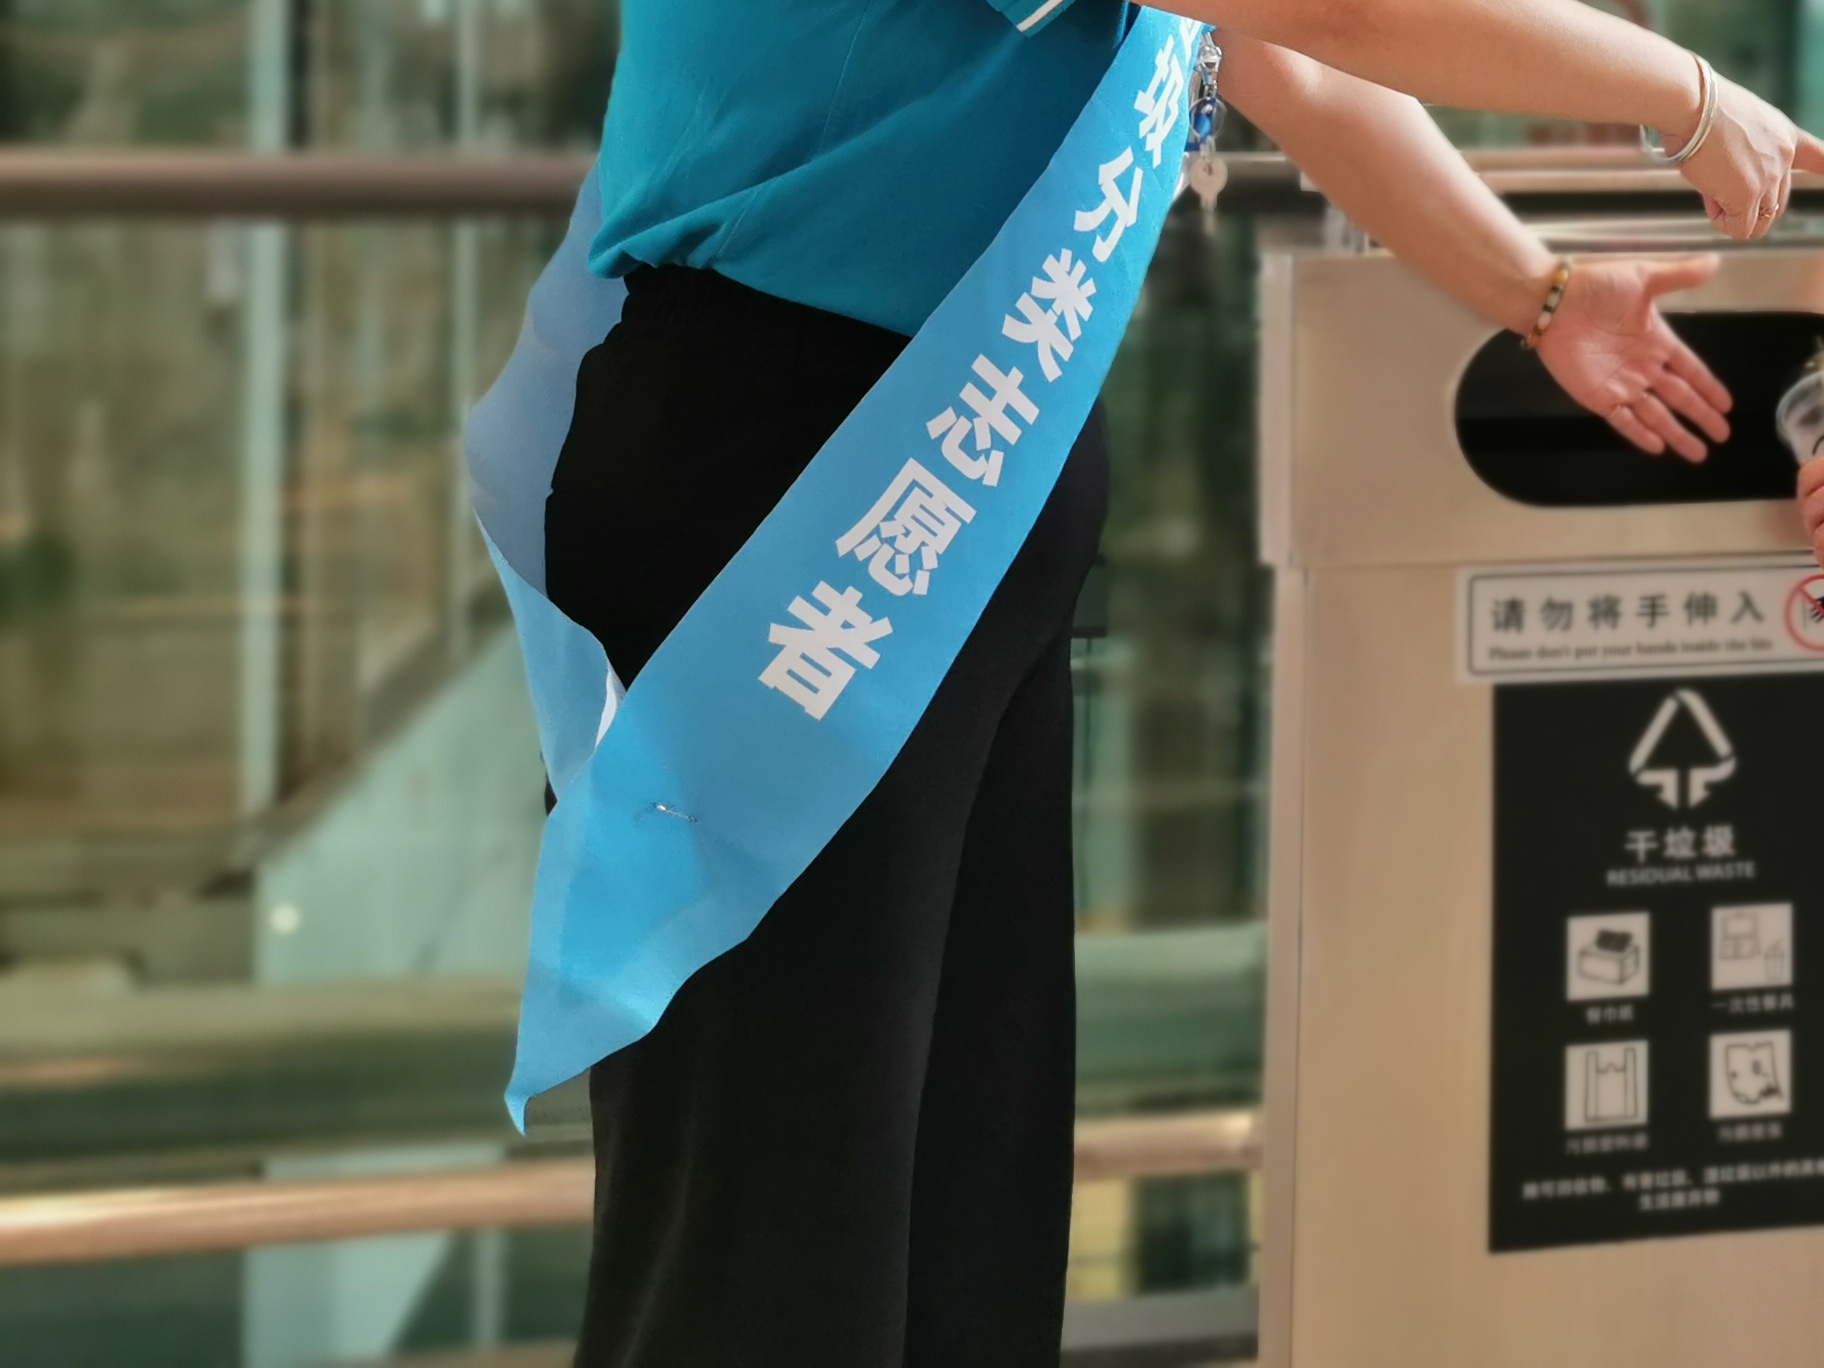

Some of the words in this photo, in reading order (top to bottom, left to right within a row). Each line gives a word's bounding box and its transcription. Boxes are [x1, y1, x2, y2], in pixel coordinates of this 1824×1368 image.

[1491, 590, 1765, 634] 请勿将手伸入
[1624, 824, 1736, 864] 干垃圾
[1606, 865, 1692, 888] RESIDUAL
[1695, 860, 1757, 881] WASTE
